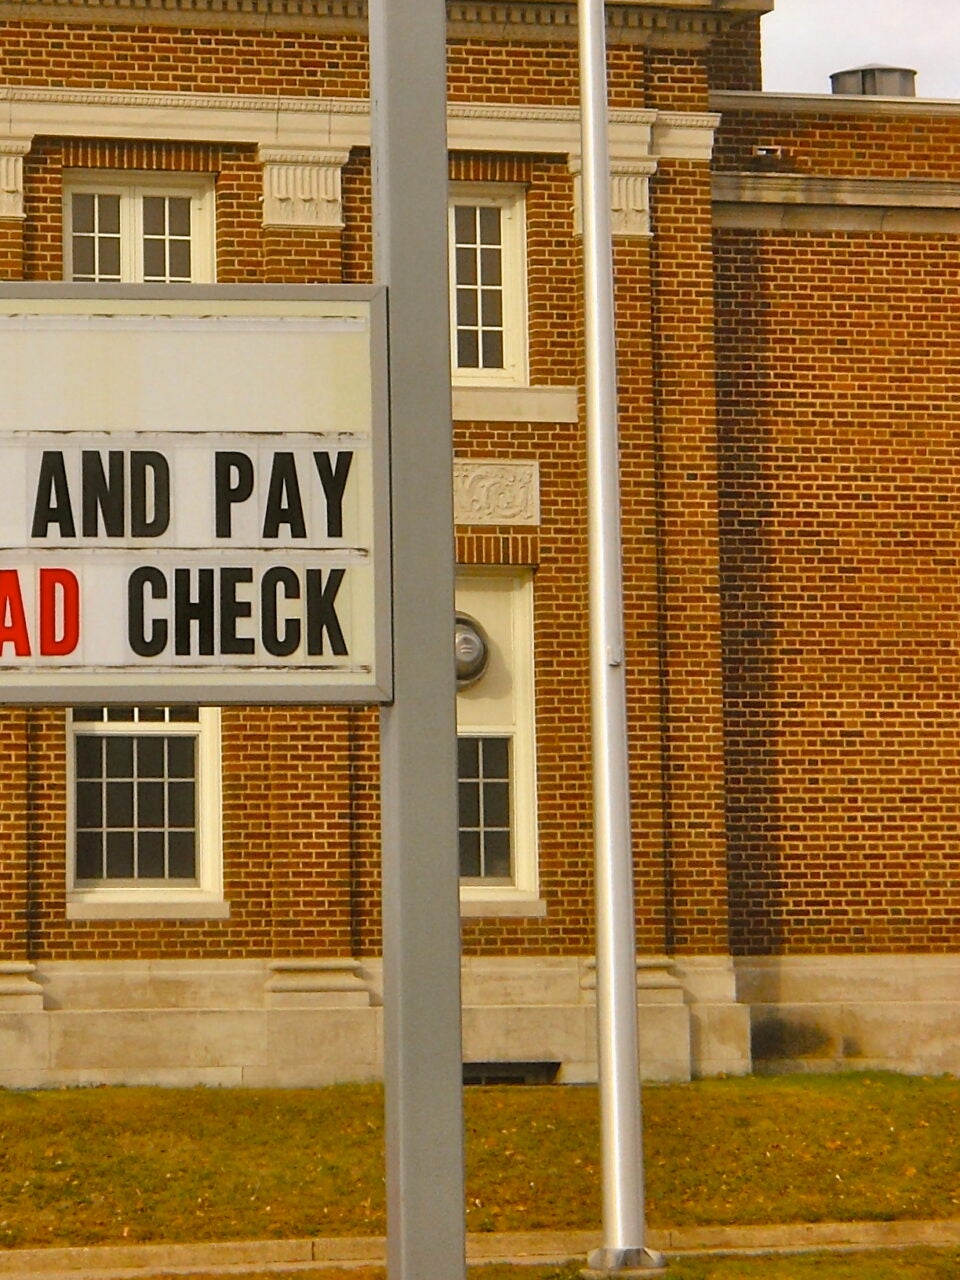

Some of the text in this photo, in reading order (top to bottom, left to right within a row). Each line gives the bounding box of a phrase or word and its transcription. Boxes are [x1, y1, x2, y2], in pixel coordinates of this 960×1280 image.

[30, 450, 171, 539] AND
[214, 450, 354, 540] PAY
[127, 565, 349, 659] CHECK
